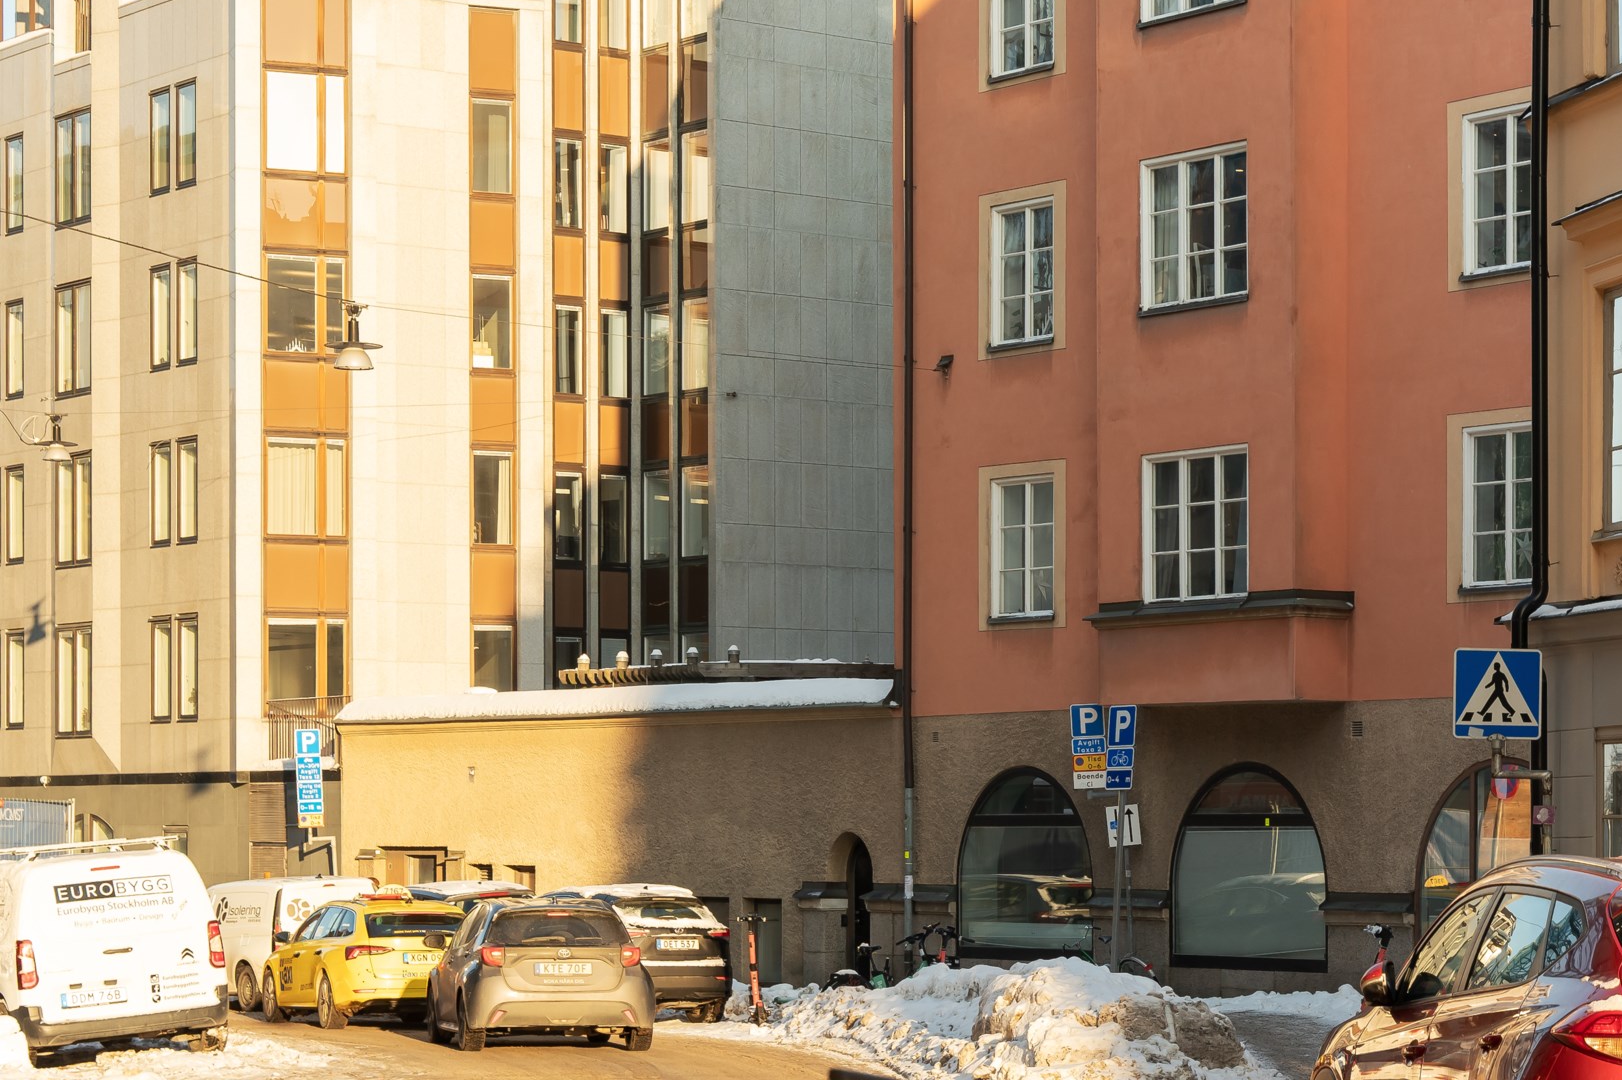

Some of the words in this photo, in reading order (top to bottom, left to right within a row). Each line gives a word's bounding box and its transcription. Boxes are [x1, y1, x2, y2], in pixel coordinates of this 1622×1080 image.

[1079, 708, 1098, 734] P
[1115, 710, 1131, 743] P
[301, 731, 316, 753] P
[1078, 739, 1100, 747] Avgift
[1107, 775, 1120, 783] 0-4
[57, 878, 169, 901] EUROBYGG
[57, 903, 105, 917] Eurobygg
[107, 899, 159, 911] Stockholm
[161, 896, 174, 905] AB
[228, 904, 262, 918] Isolering
[681, 939, 696, 948] 537
[410, 953, 428, 962] XGN
[543, 962, 564, 973] KTE
[567, 962, 587, 973] 70F
[71, 991, 95, 1004] DDM
[98, 989, 121, 1000] 76B
